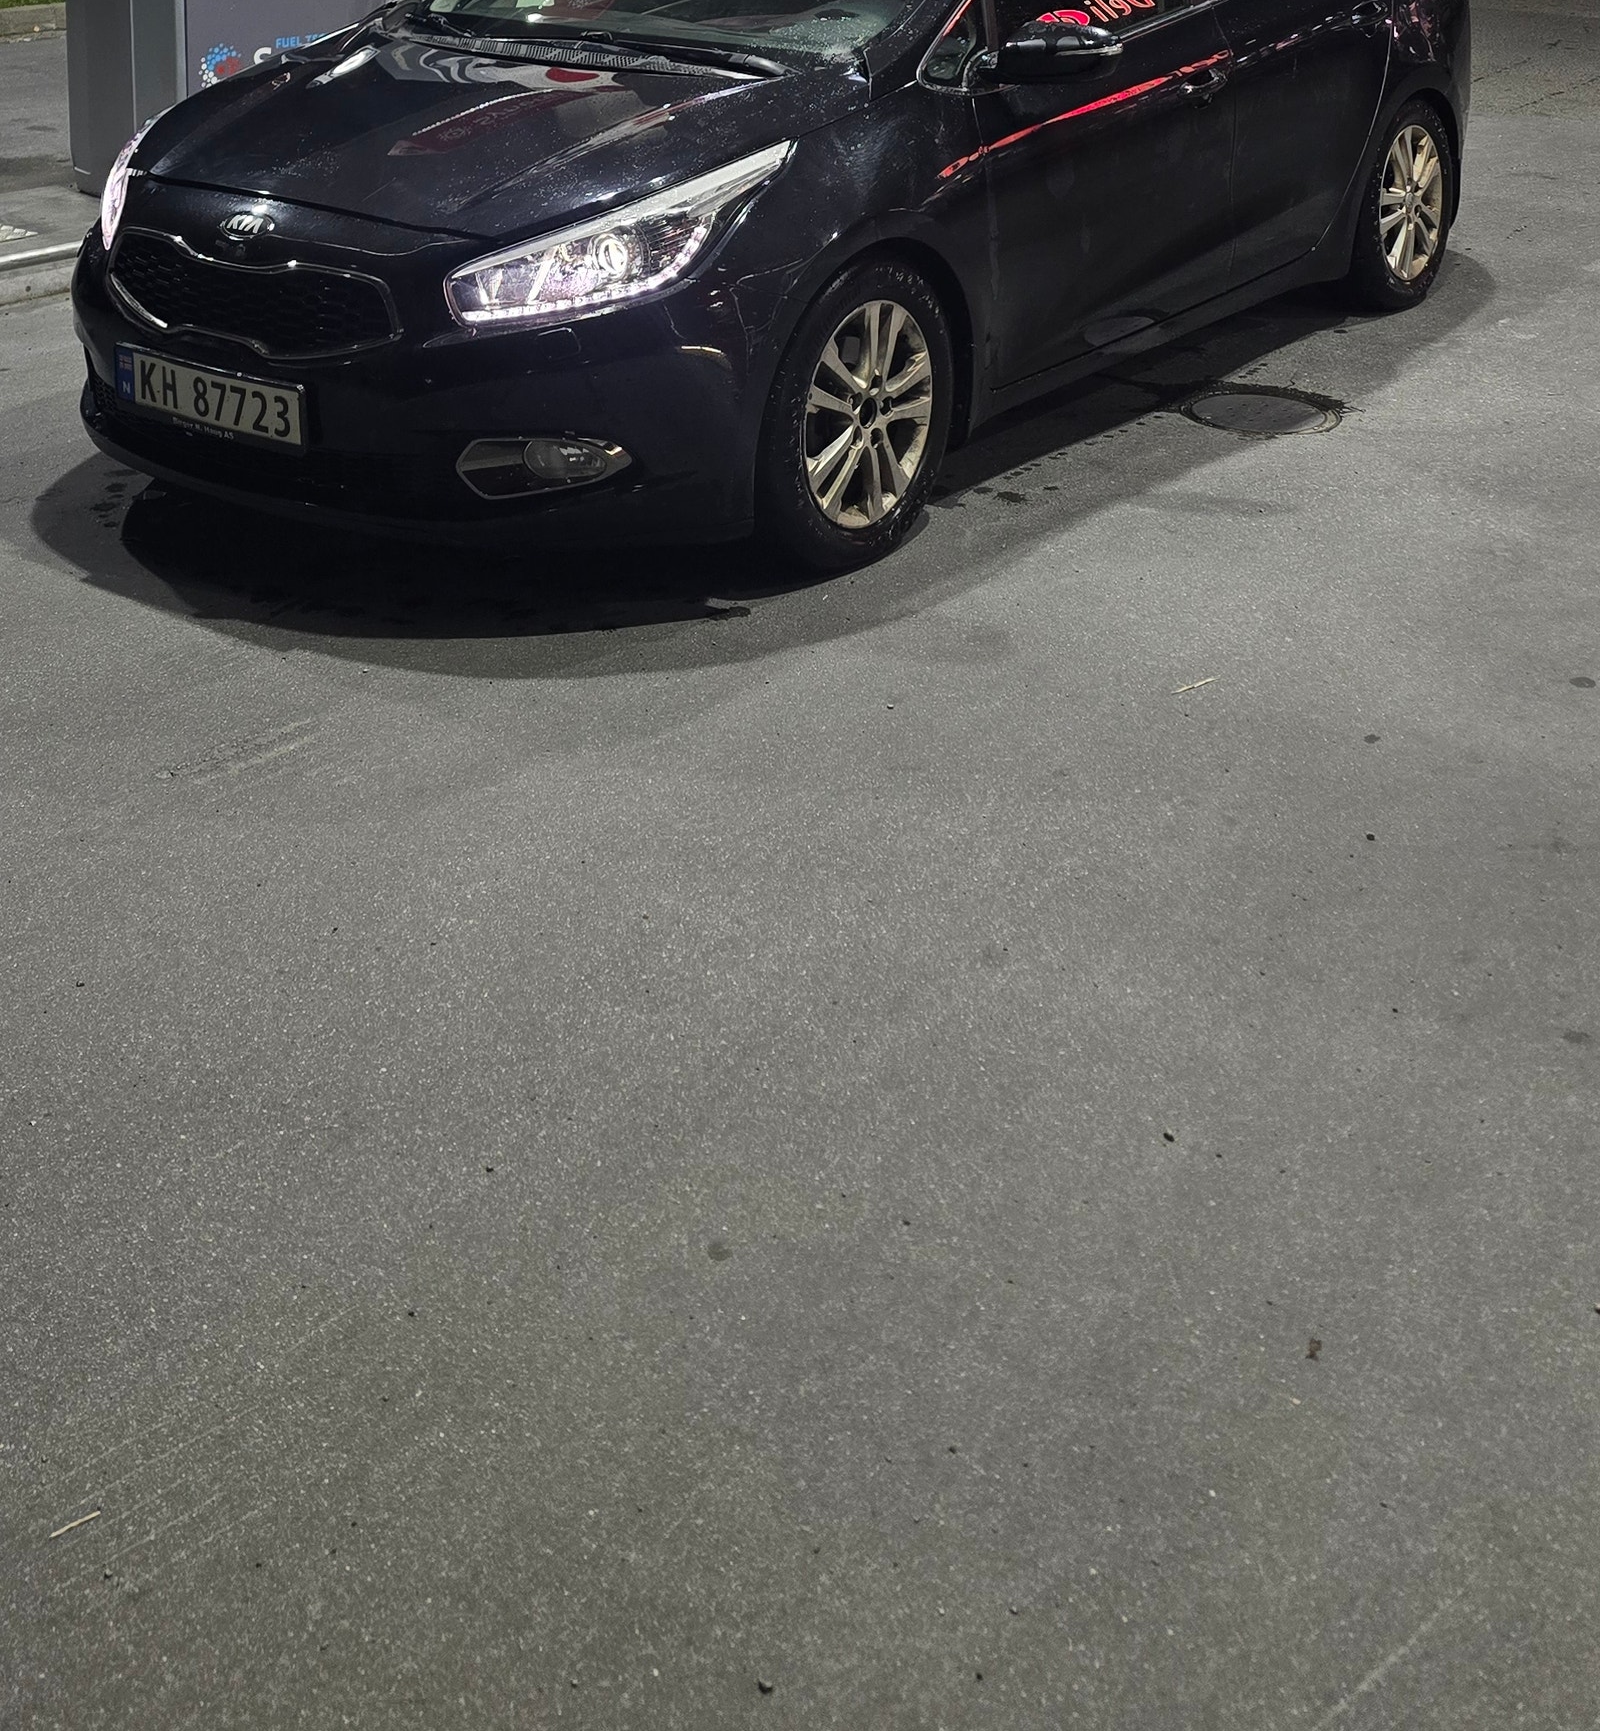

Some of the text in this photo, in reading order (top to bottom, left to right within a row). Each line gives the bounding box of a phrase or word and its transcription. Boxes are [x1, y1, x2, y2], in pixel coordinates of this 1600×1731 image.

[275, 36, 302, 49] FUEL
[227, 214, 264, 234] KIA
[122, 381, 131, 394] N
[140, 360, 291, 437] KH 87723
[224, 431, 234, 440] AS
